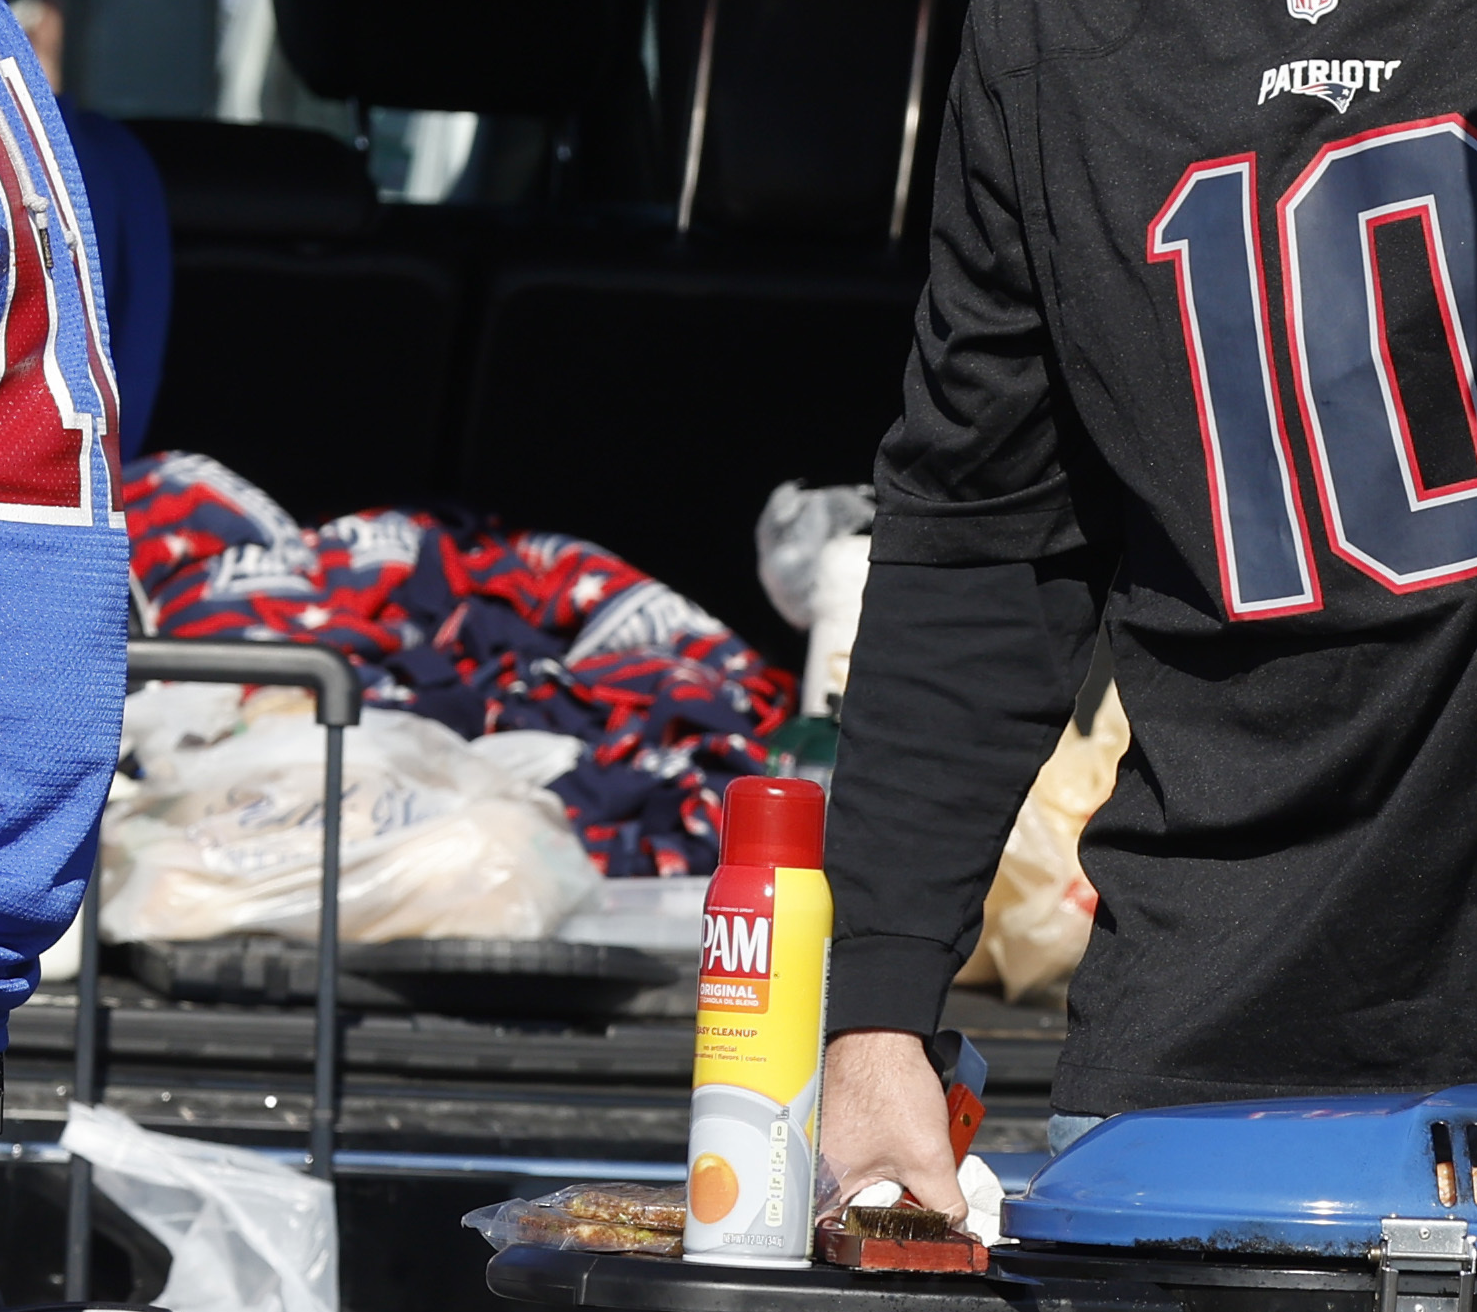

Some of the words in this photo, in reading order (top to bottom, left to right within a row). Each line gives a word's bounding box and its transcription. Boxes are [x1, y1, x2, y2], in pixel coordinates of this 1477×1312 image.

[699, 914, 769, 974] PAM
[700, 983, 757, 999] ORIGINAL
[712, 1027, 758, 1037] CLEANUP
